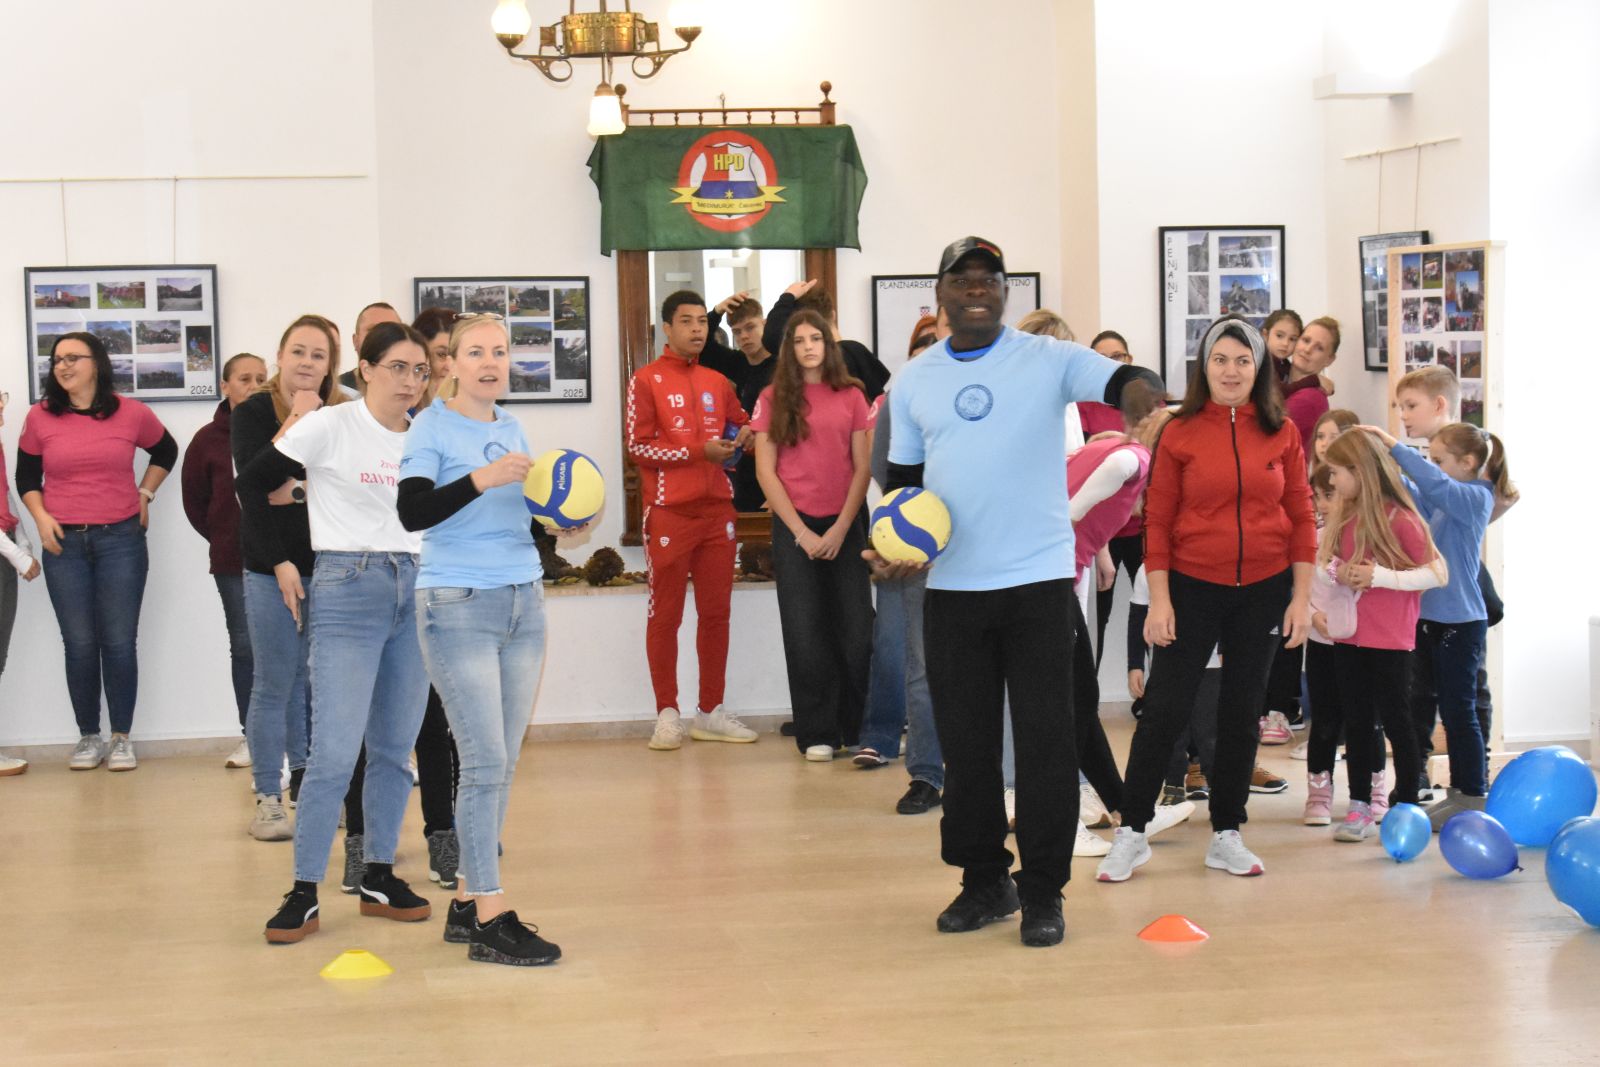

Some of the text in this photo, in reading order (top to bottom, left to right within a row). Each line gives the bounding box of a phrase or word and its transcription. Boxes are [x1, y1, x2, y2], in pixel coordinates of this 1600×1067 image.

[713, 153, 745, 171] HPD
[879, 280, 933, 289] PLANINARSKI
[667, 394, 685, 408] 19
[360, 472, 400, 487] RAVN
